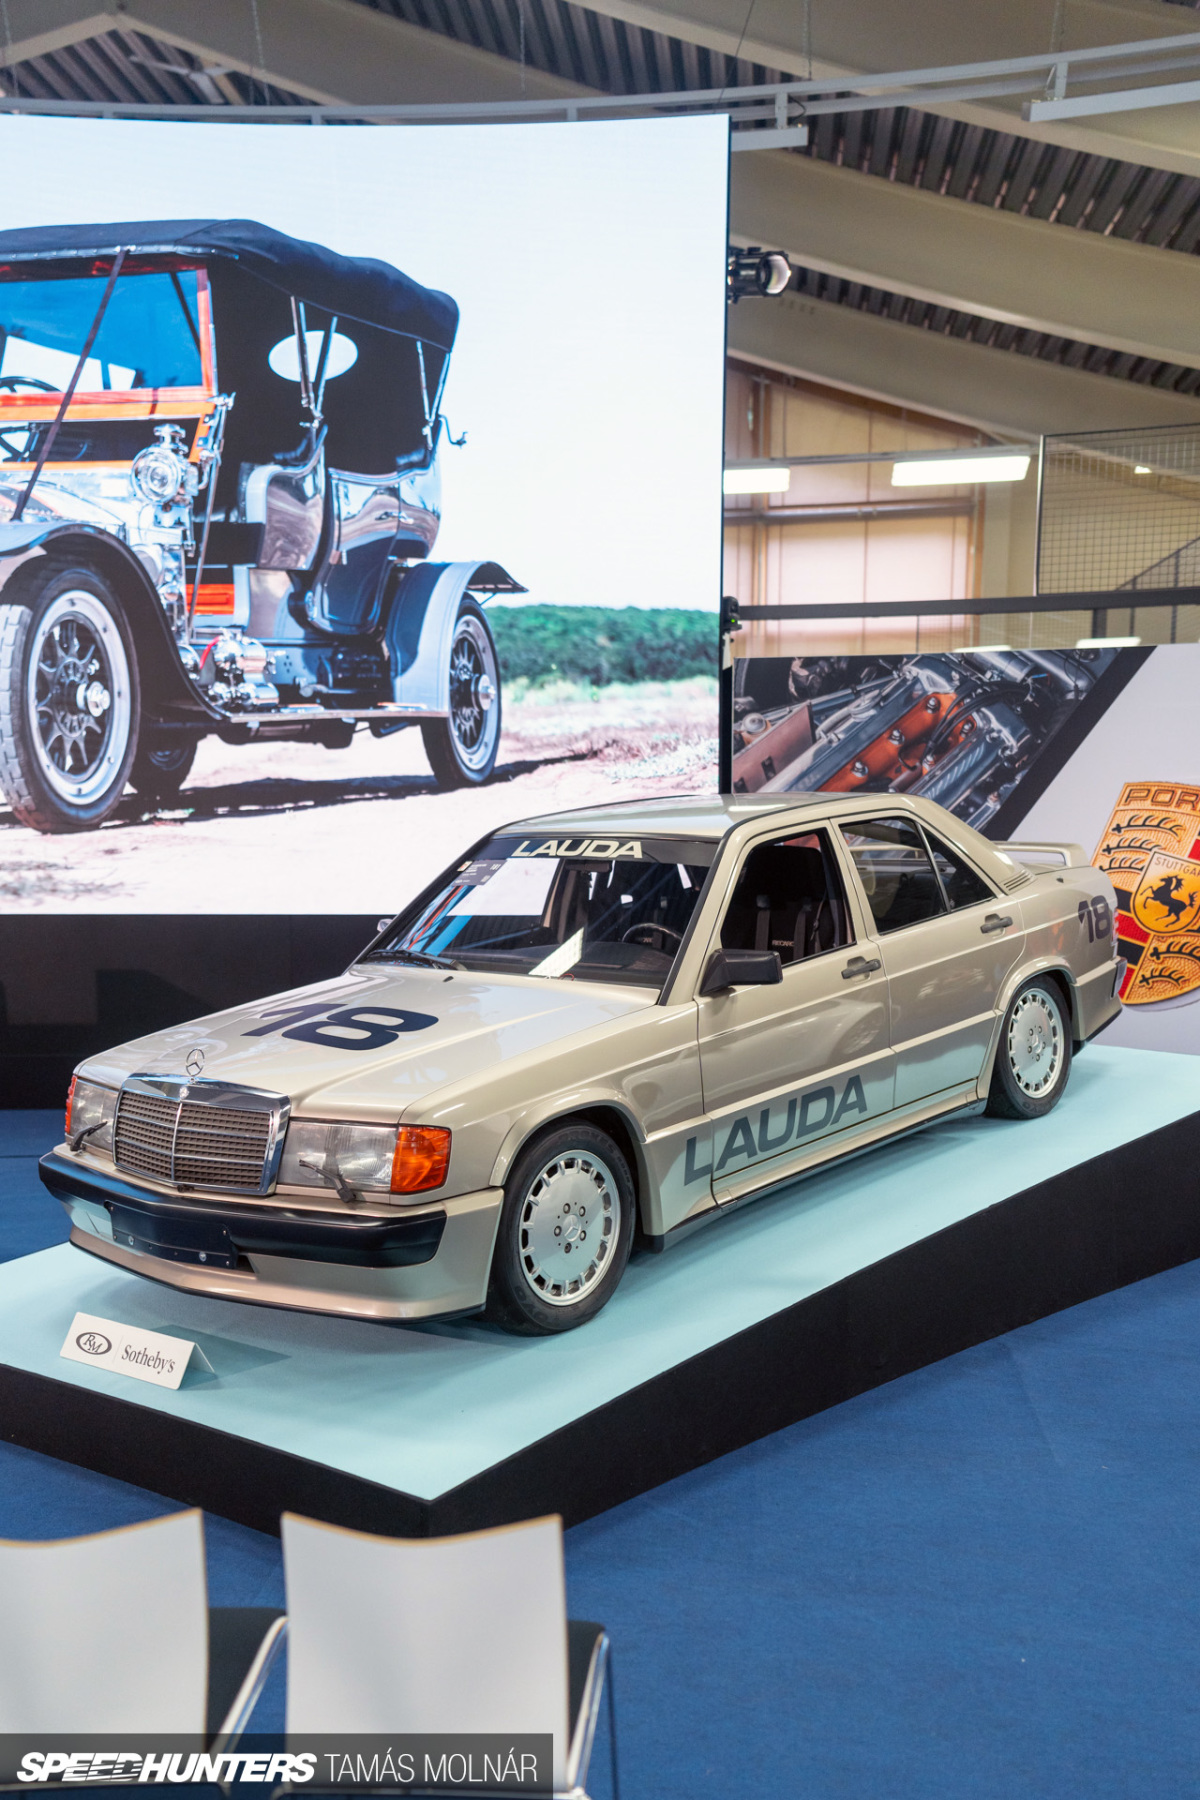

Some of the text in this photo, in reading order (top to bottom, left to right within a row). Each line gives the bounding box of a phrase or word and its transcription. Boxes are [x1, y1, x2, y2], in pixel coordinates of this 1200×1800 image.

[510, 839, 643, 859] LAUDA
[1078, 894, 1112, 944] 18
[239, 1003, 440, 1051] 18
[683, 1074, 868, 1187] LAUDA
[83, 1334, 176, 1375] RM Sotheby's
